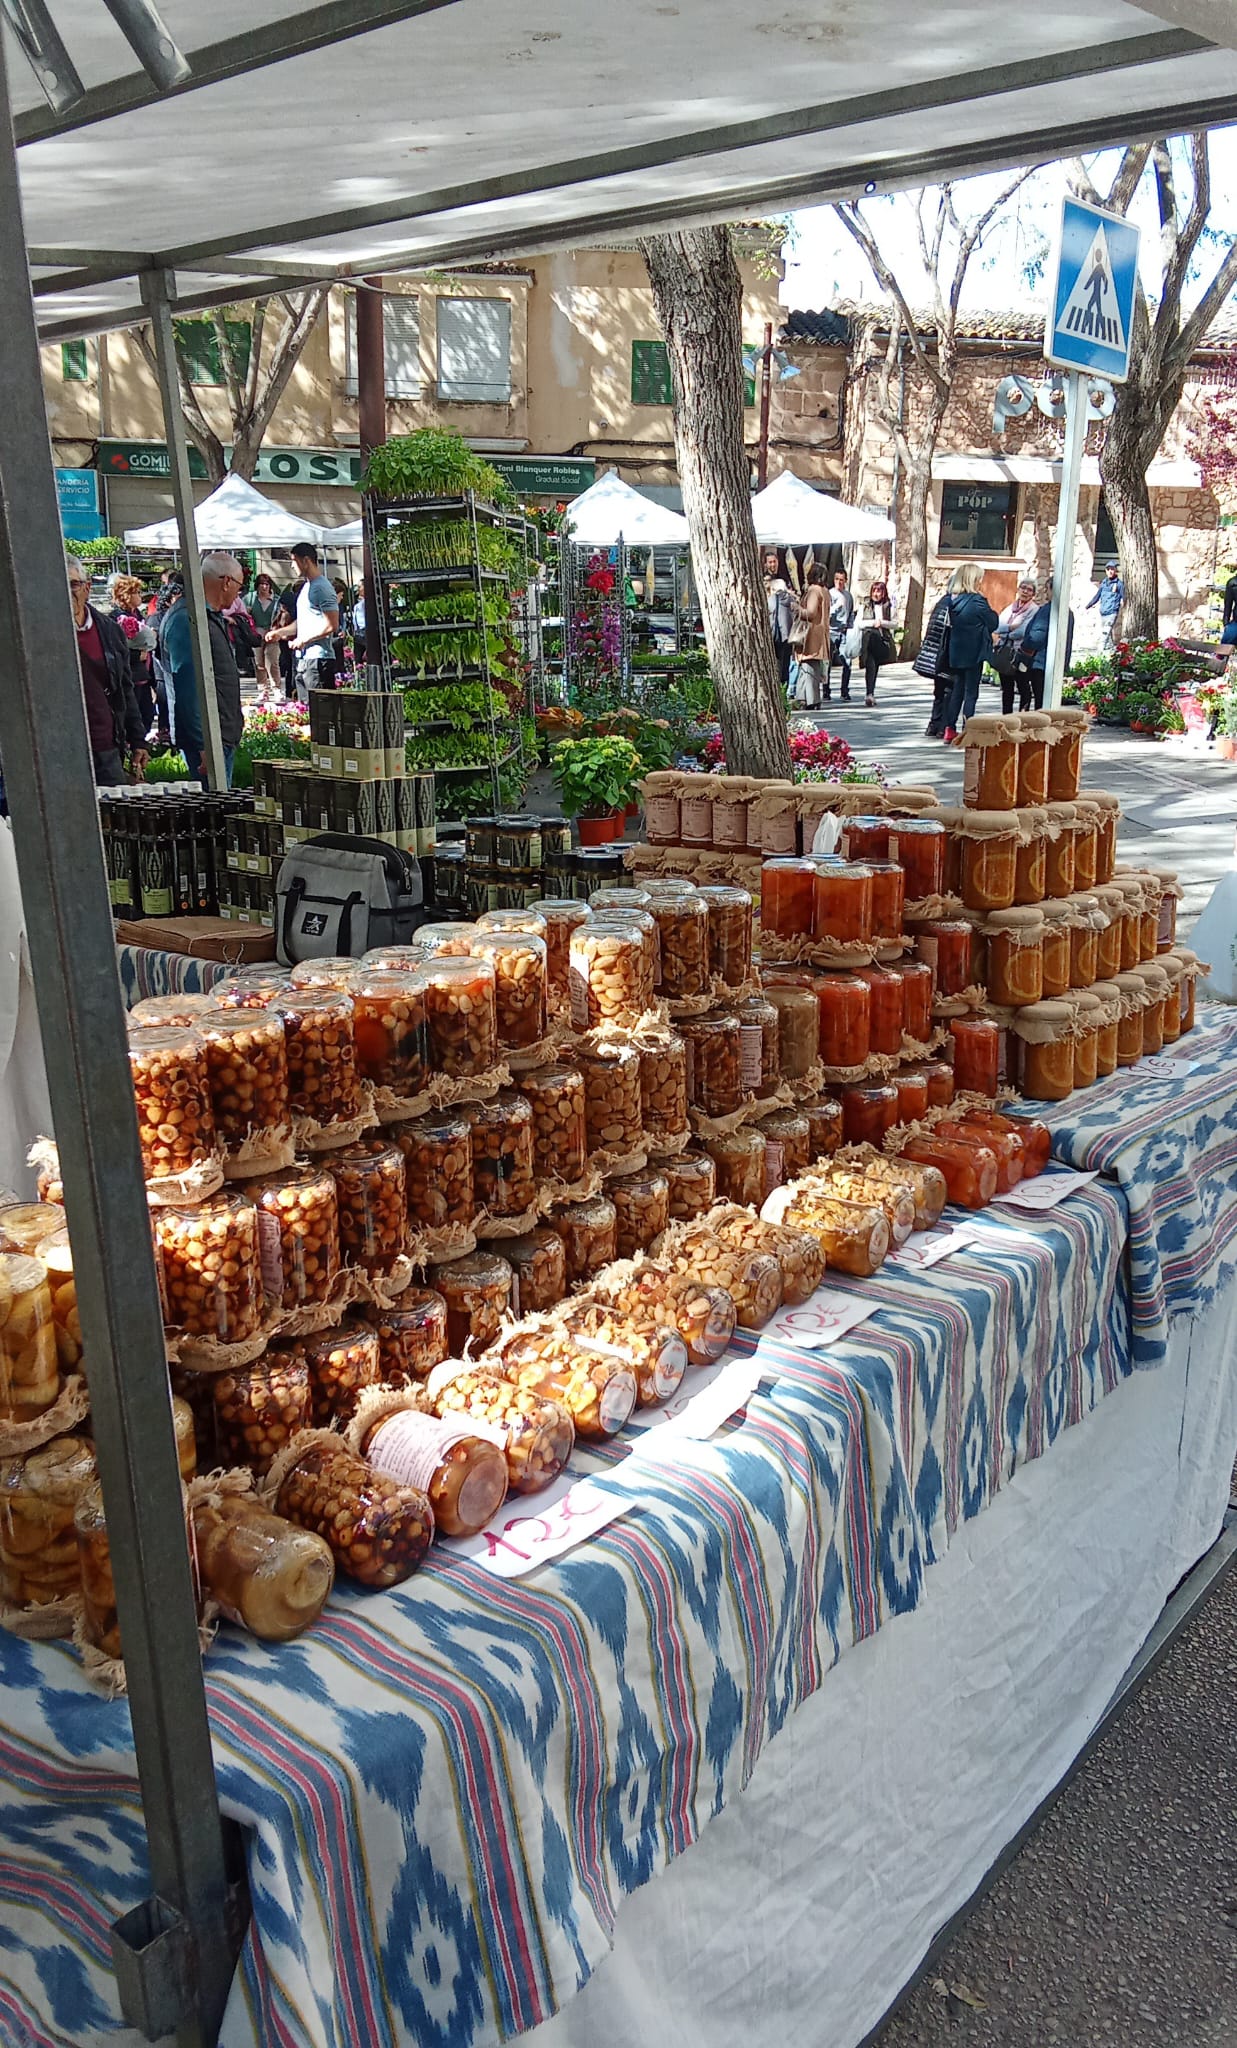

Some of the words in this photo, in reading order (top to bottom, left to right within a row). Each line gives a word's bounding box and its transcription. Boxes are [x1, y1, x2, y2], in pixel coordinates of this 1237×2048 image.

[496, 464, 514, 473] Toni
[515, 465, 552, 475] Blanquer
[553, 466, 581, 475] Robles
[561, 475, 580, 484] Social
[958, 495, 993, 508] POP
